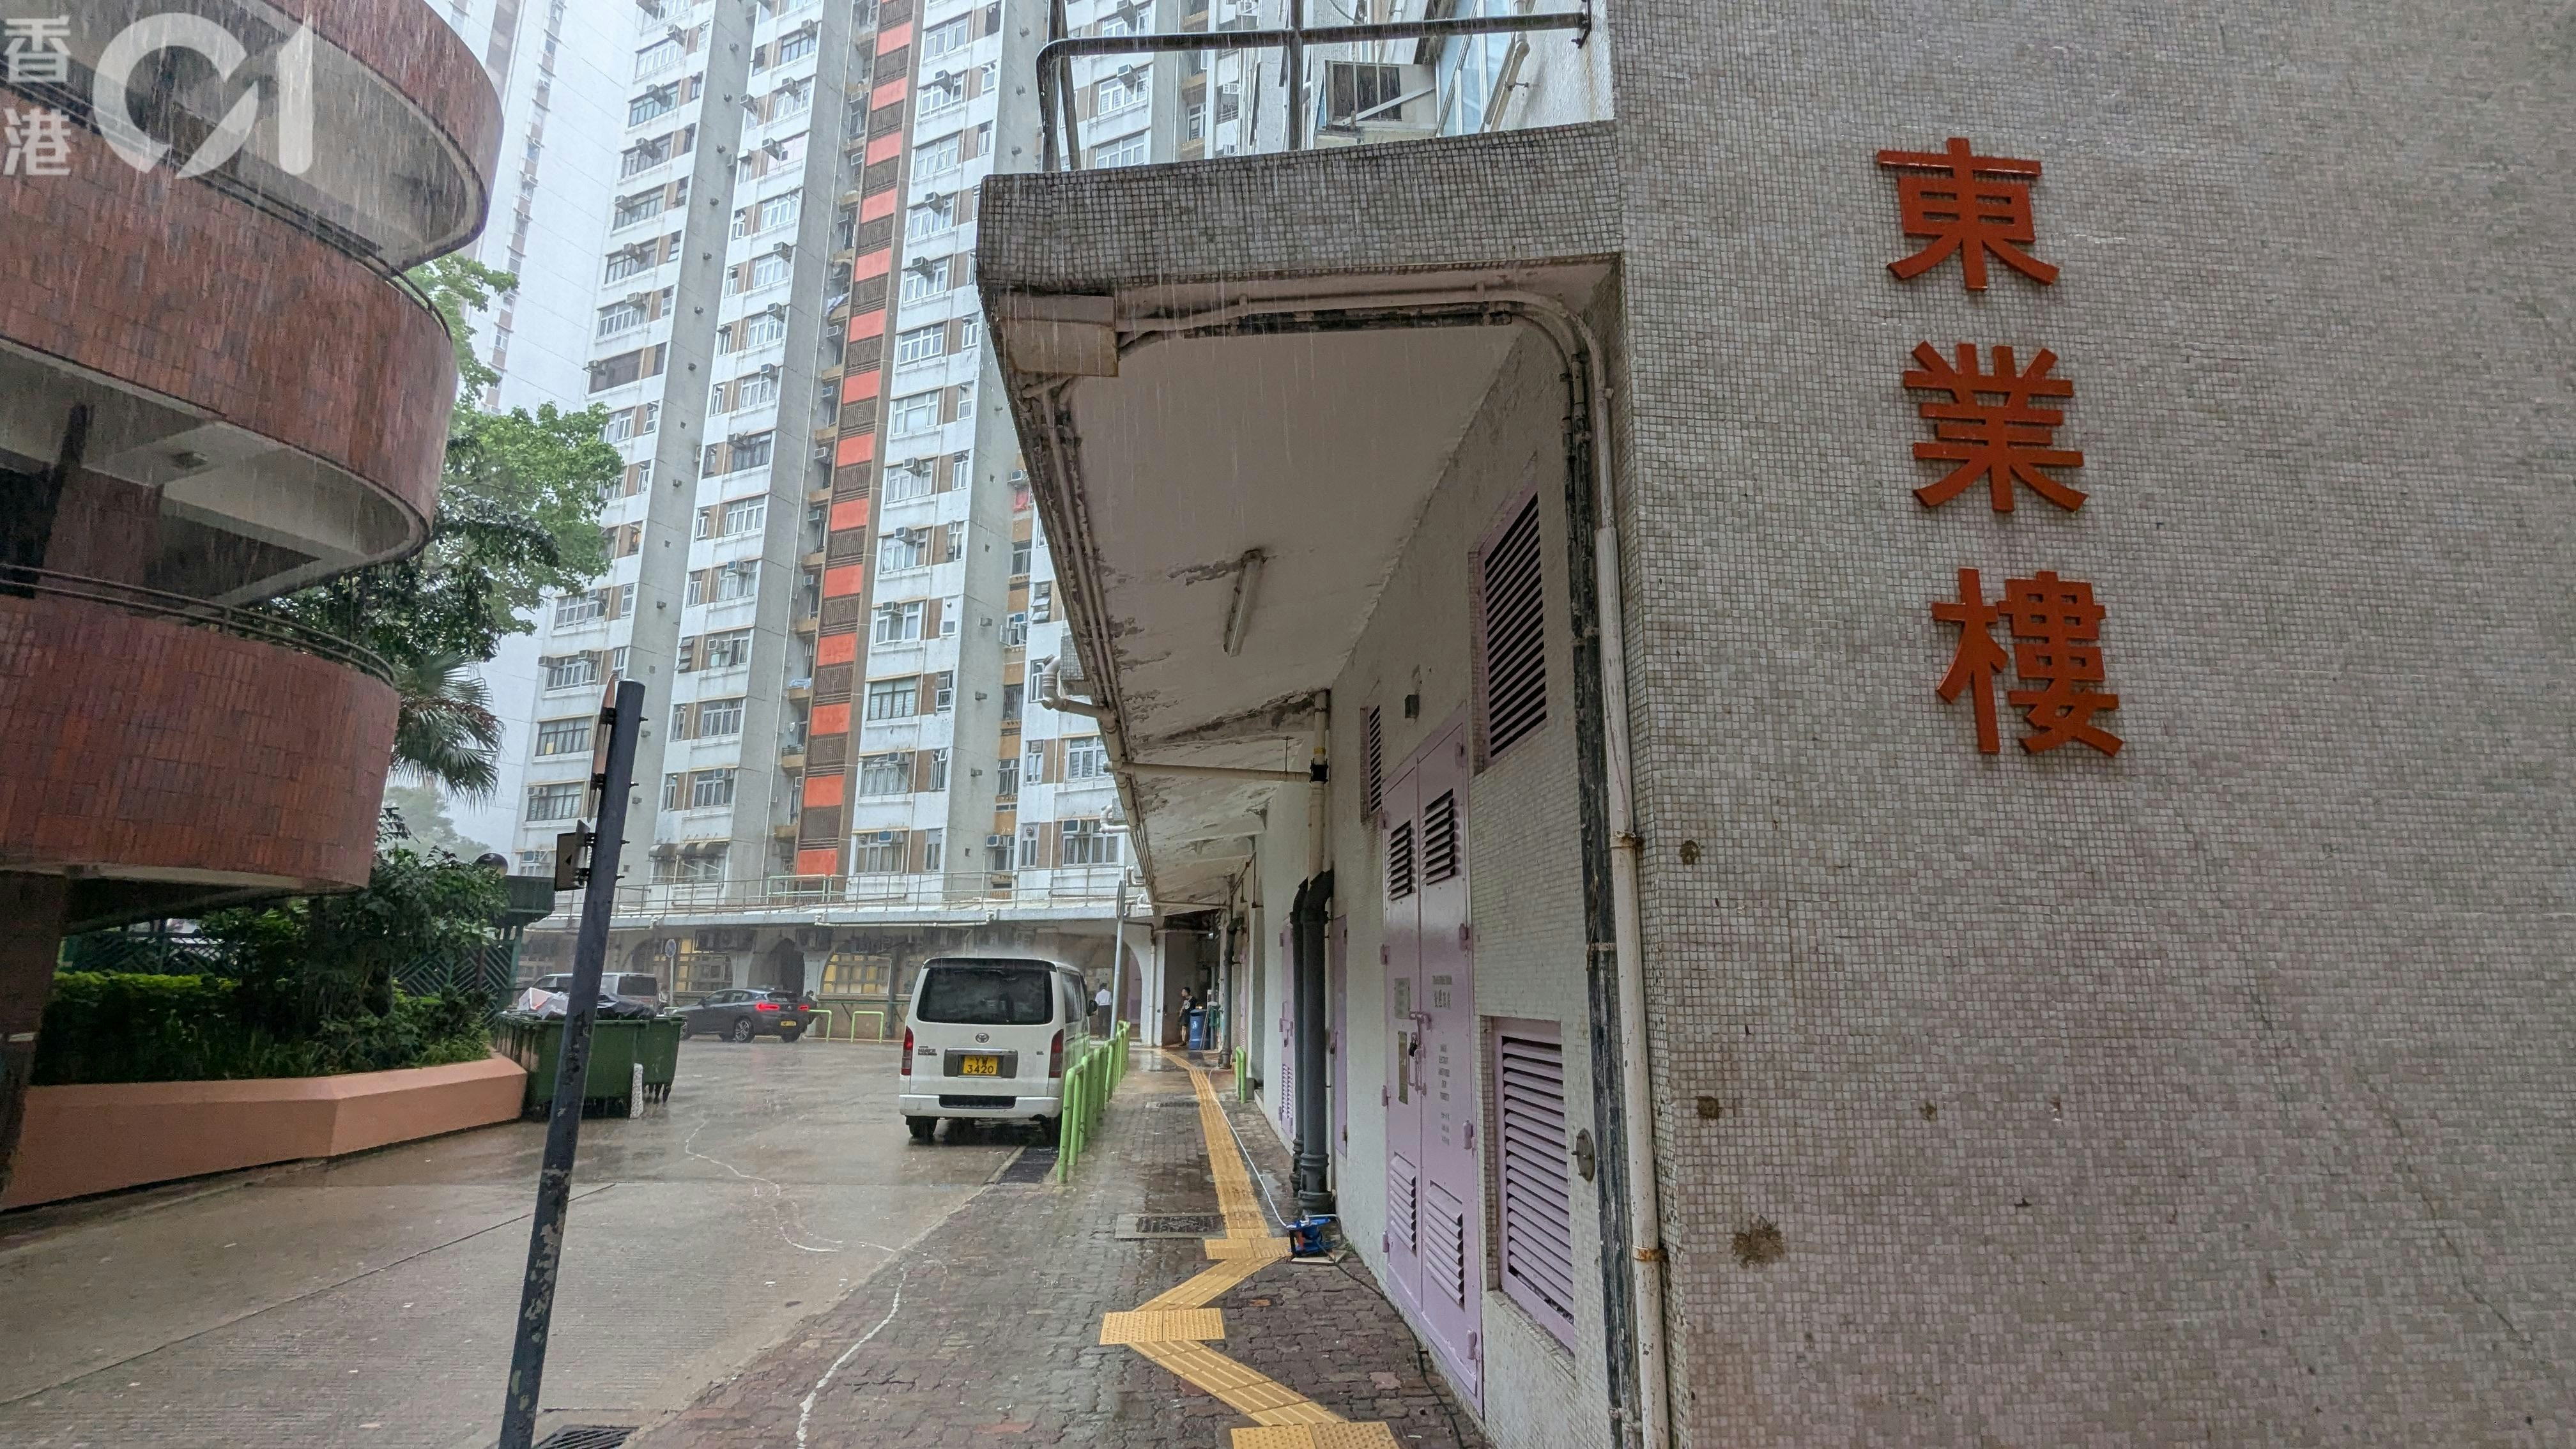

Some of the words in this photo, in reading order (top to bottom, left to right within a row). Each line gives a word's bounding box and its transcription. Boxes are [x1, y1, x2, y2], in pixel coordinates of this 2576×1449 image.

[1876, 137, 2123, 756] 東業樓
[967, 1064, 993, 1074] 3420
